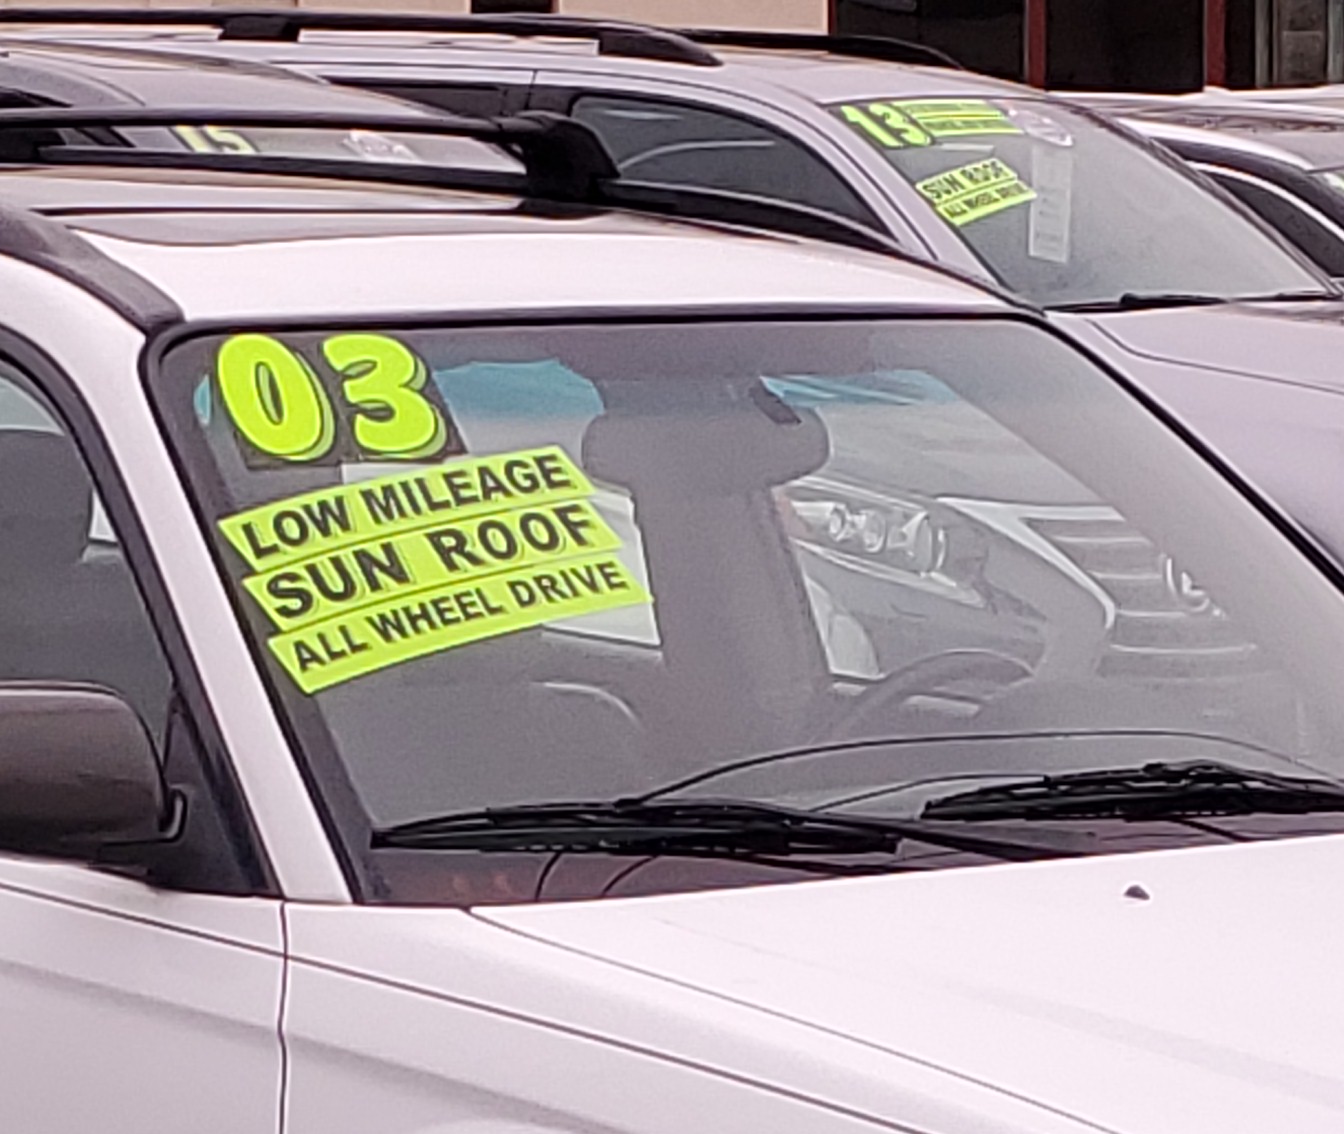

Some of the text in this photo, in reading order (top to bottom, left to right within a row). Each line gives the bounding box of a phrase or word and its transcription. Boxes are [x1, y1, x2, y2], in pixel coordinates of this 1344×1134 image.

[840, 103, 932, 148] 13
[218, 333, 446, 461] 03
[241, 454, 574, 560] LOW MILEAGE
[265, 504, 594, 620] SUN ROOF
[291, 560, 628, 672] ALL WHEEL DRIVE
